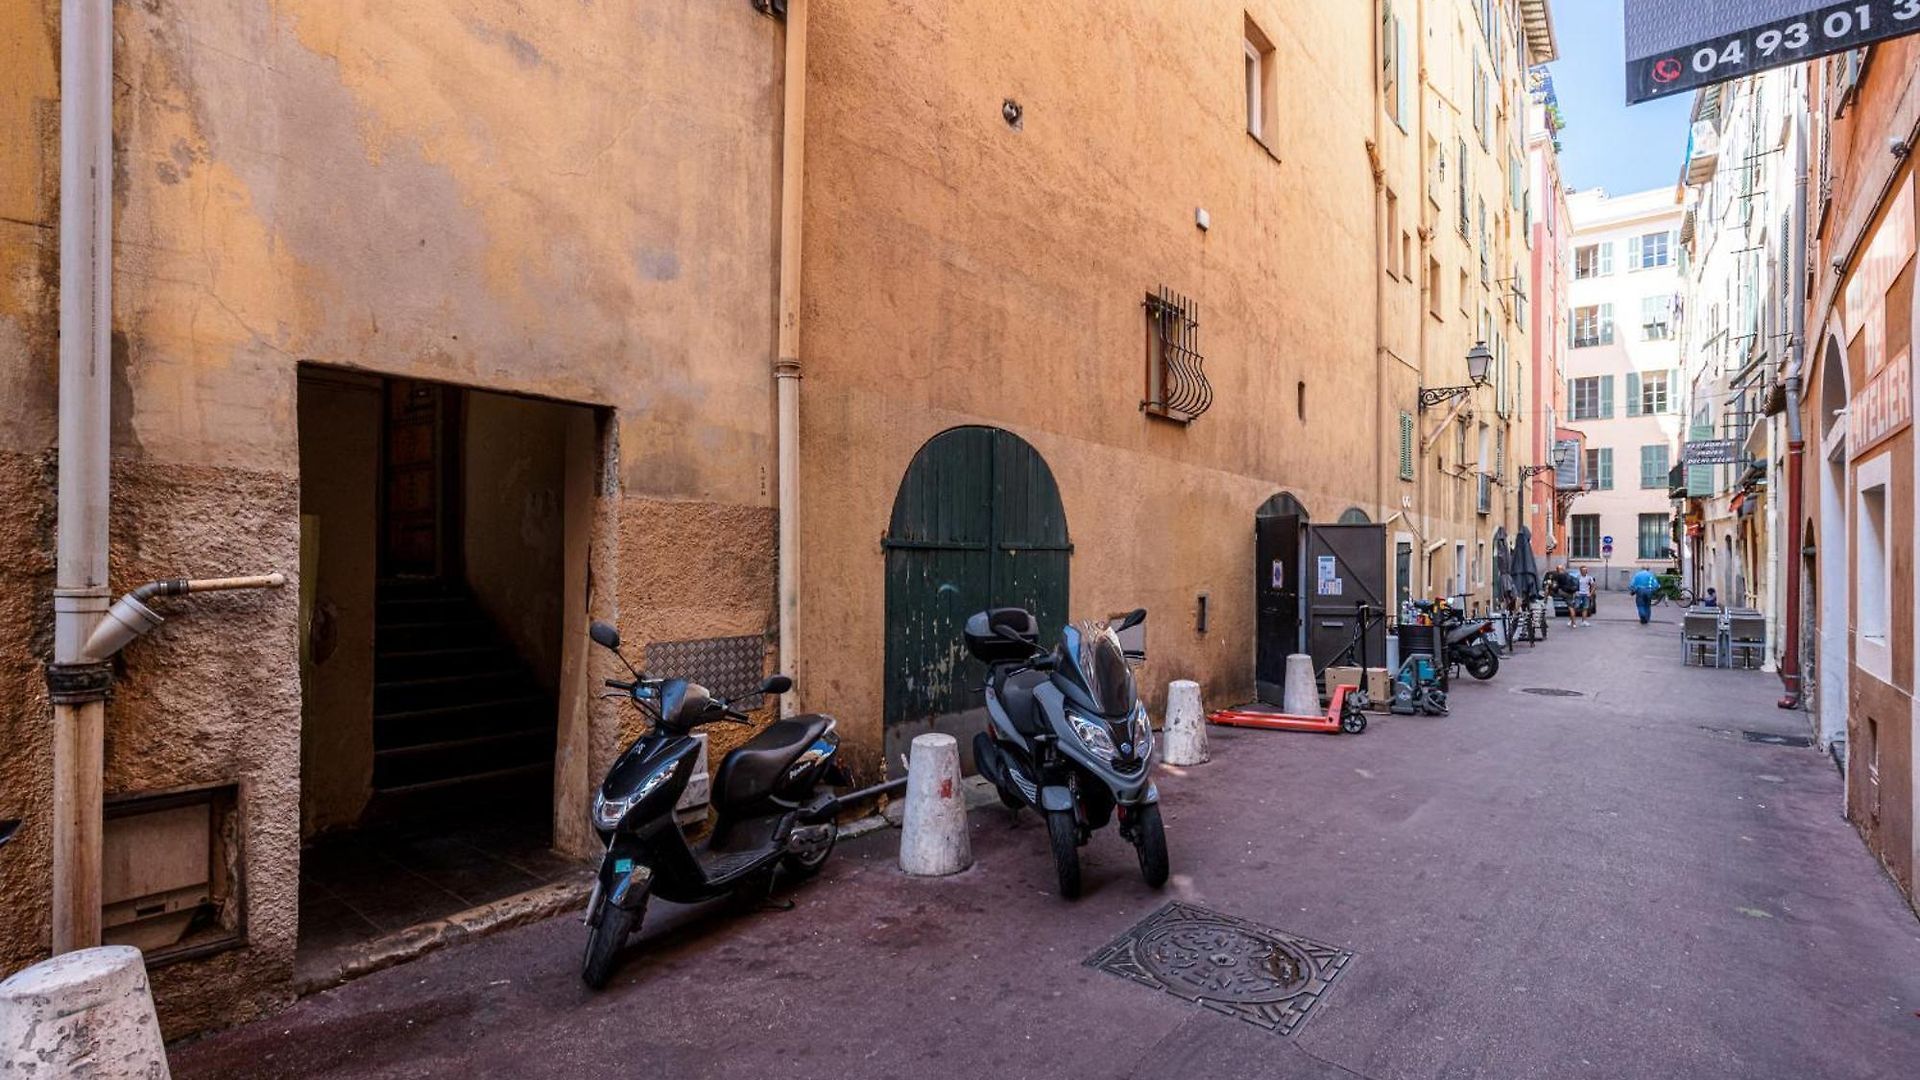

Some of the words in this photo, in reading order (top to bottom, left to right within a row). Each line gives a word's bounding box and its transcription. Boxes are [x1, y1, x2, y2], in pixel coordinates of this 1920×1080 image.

[1692, 39, 1744, 73] 04
[1755, 22, 1810, 56] 93
[1823, 6, 1871, 38] 01
